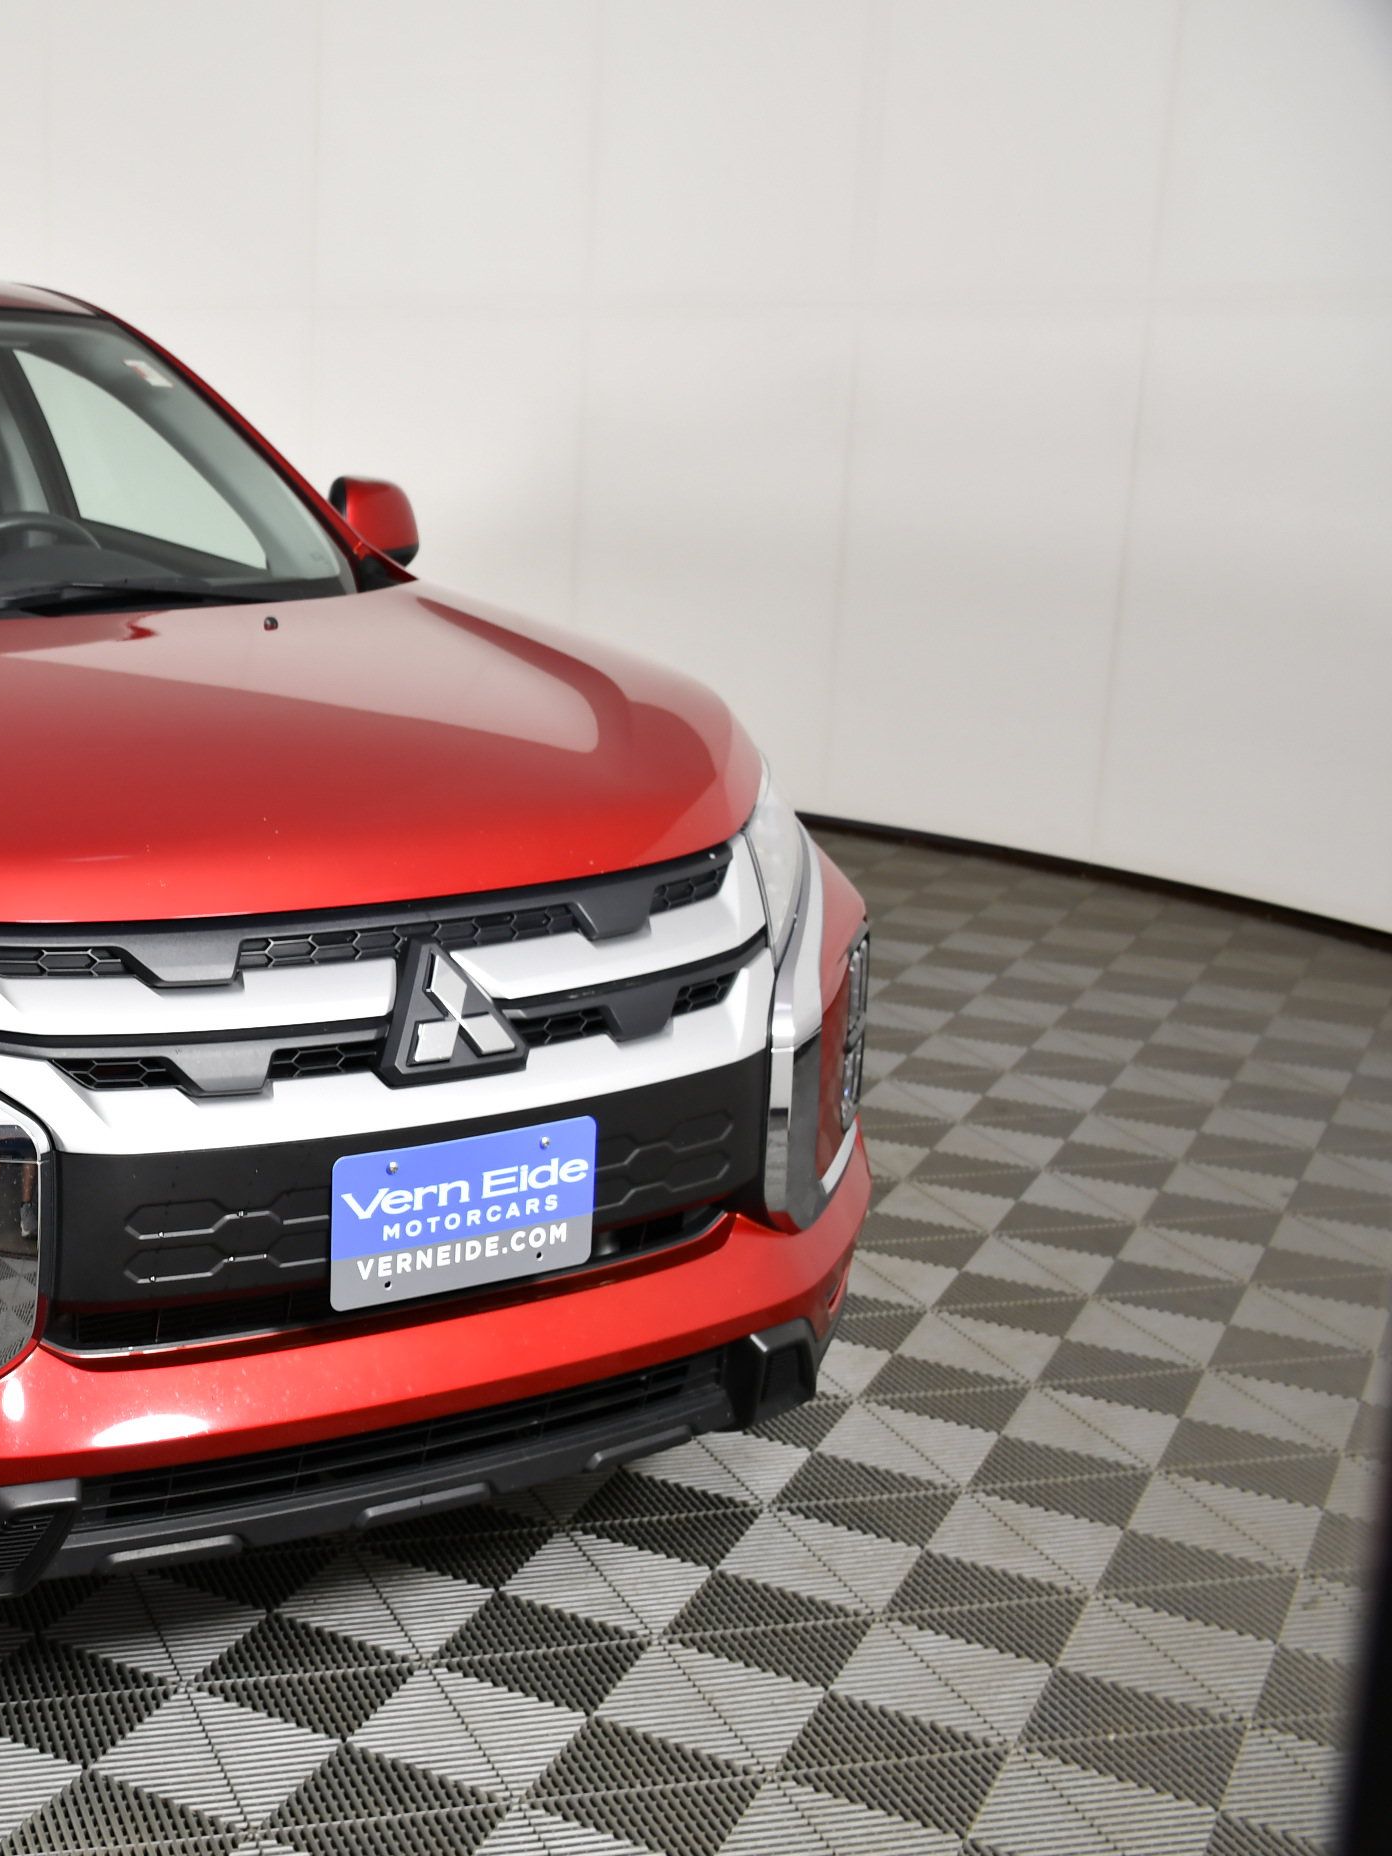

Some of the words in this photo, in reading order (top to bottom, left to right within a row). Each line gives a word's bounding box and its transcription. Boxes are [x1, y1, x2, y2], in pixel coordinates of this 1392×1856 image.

[341, 1179, 470, 1220] Vern
[481, 1157, 587, 1199] Eide
[382, 1194, 558, 1241] MOTORCARS
[357, 1223, 567, 1281] VERNEIDE.COM
